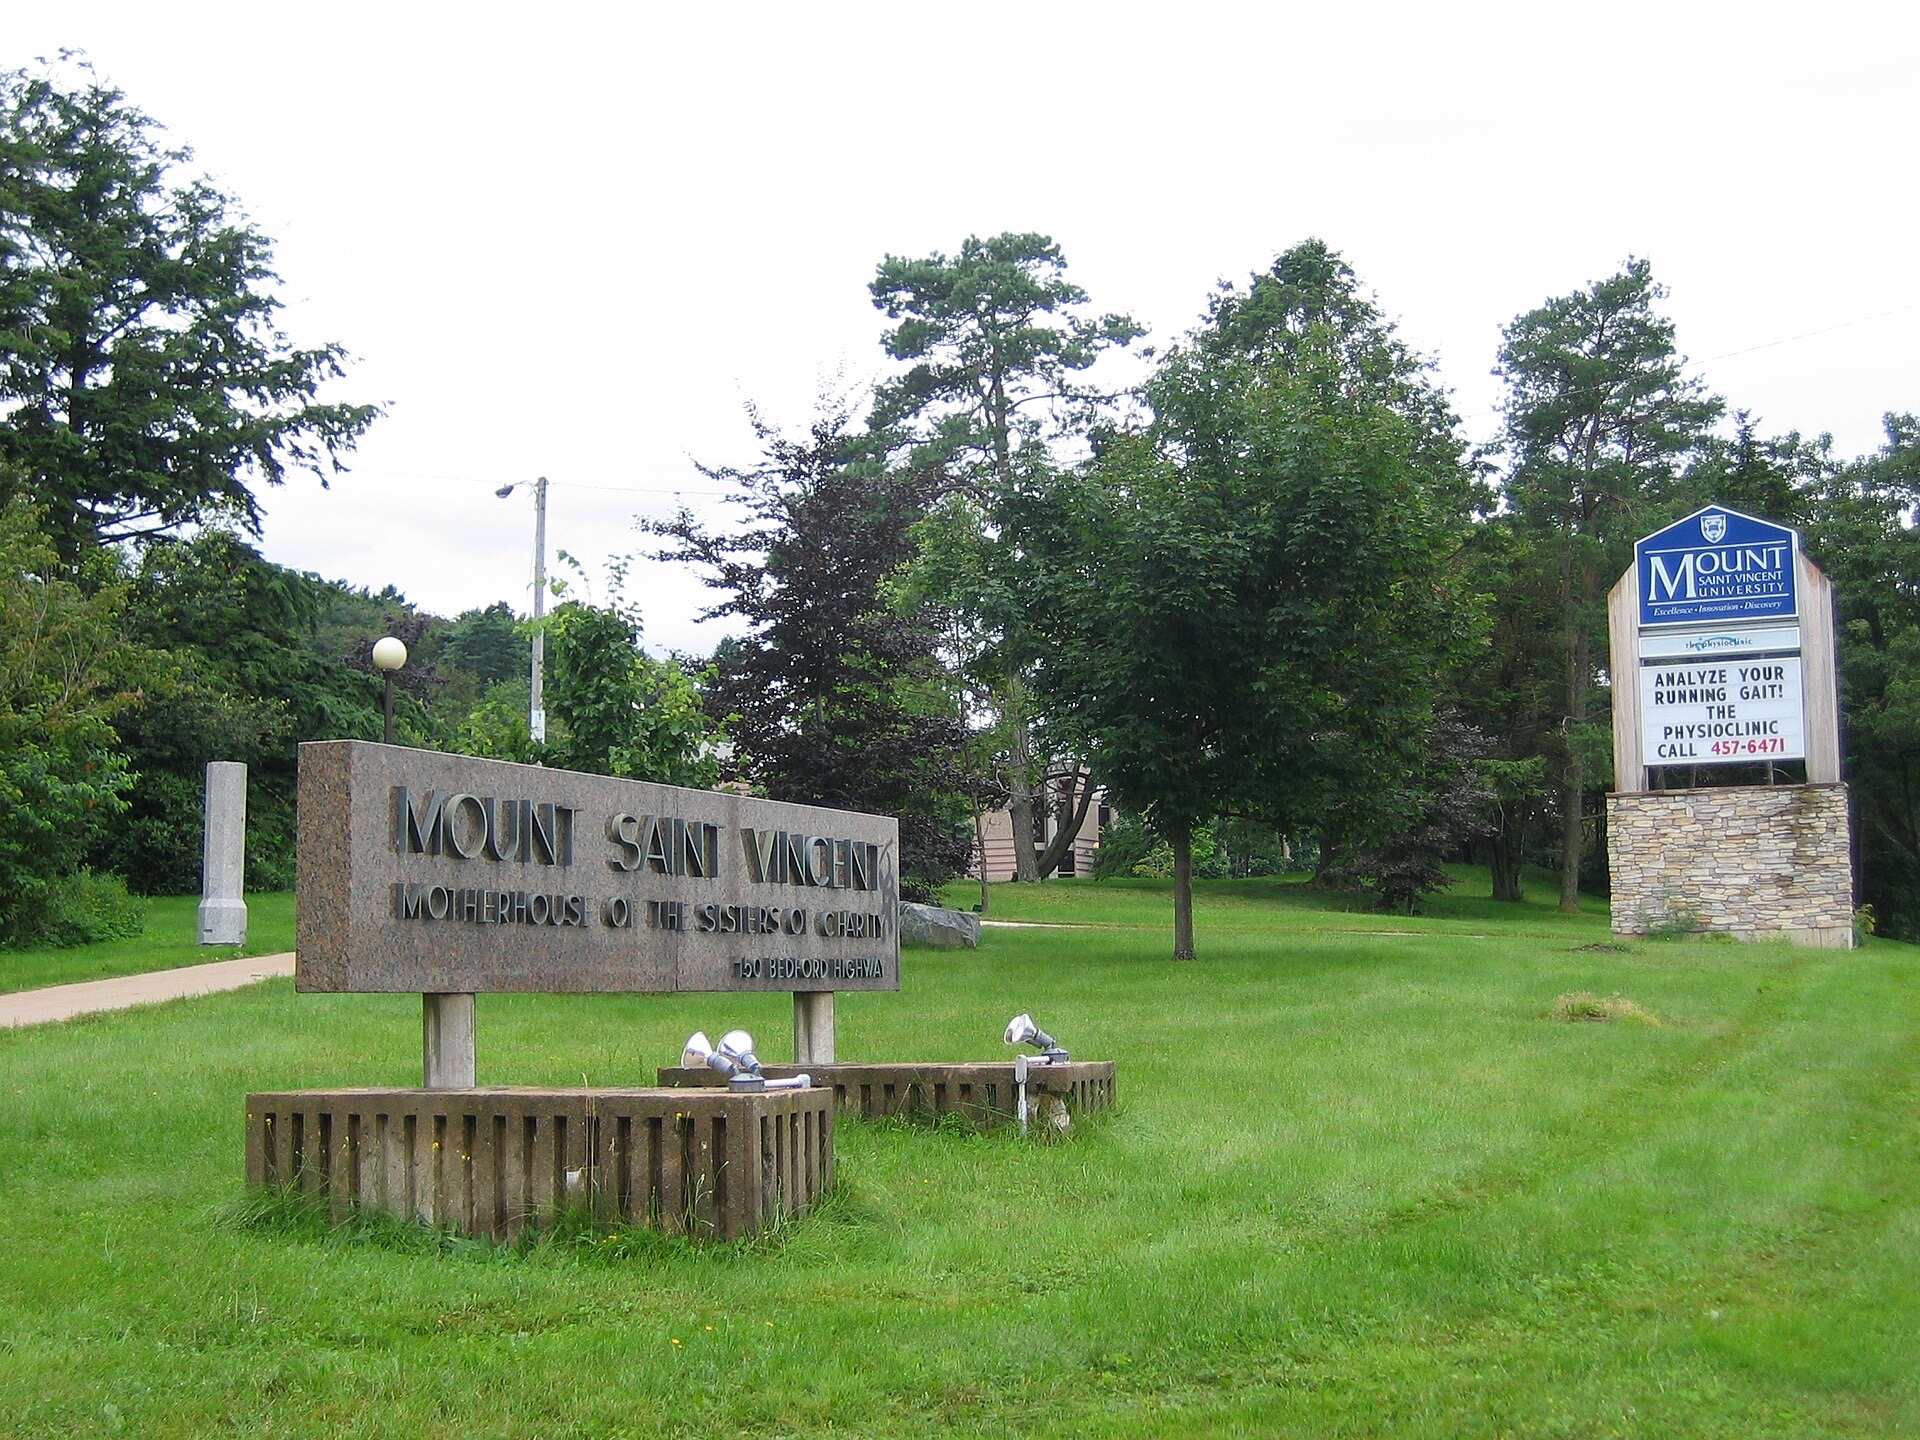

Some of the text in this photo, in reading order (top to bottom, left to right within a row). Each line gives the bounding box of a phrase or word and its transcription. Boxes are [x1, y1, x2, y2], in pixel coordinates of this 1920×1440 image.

[1648, 546, 1788, 601] MOUNT
[1699, 571, 1784, 587] SAINT VINCENT
[1698, 582, 1785, 598] UNIVERSITY
[1653, 601, 1782, 617] Excellence Innovation Discovery
[1654, 666, 1785, 687] ANALYZE YOUR
[1654, 684, 1783, 705] RUNNING GAIT!
[1706, 704, 1737, 720] THE
[1663, 720, 1779, 740] PHYSIOCLINIC
[1657, 738, 1785, 758] CALL 457-6471
[389, 786, 884, 891] MOUNT SAINT VINCENT
[391, 883, 593, 928] MOTHERHOUSE
[644, 899, 690, 931] THE
[695, 903, 780, 935] SISTERS
[815, 910, 886, 938] CHARITY
[765, 957, 828, 978] BEDFORD
